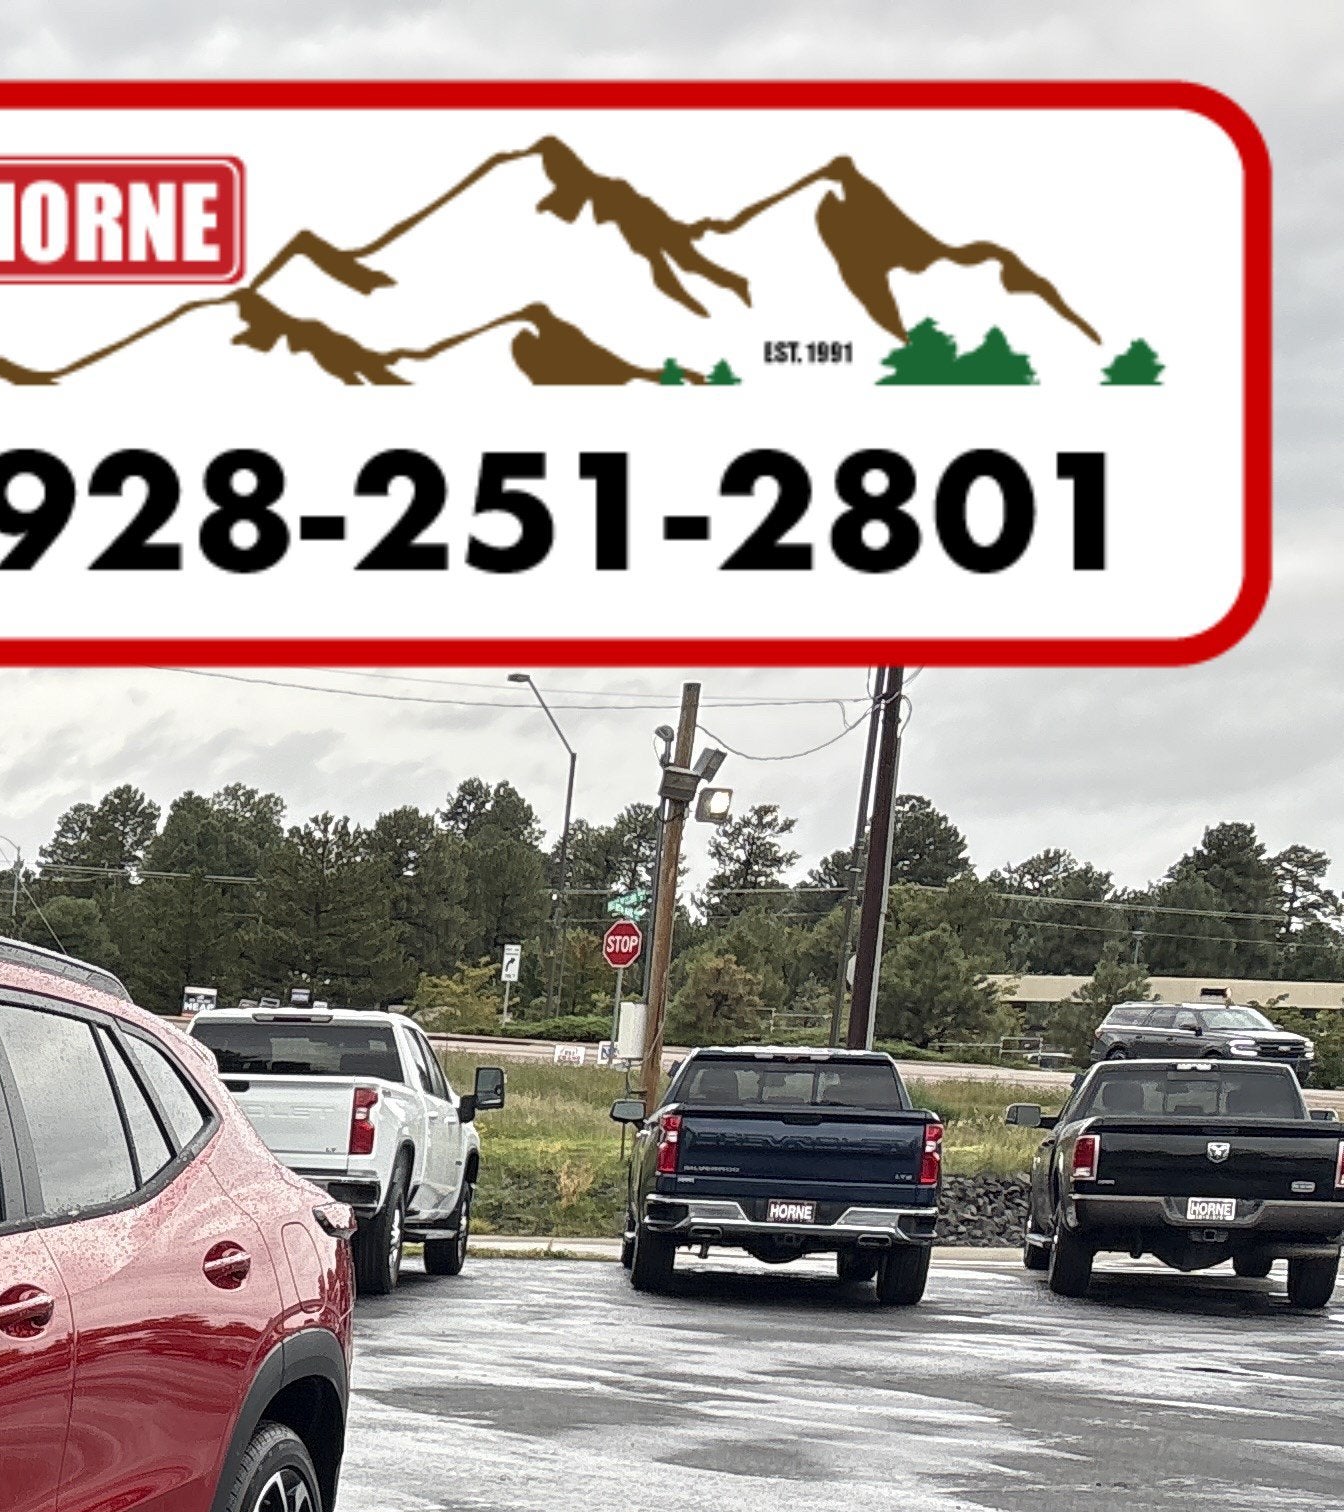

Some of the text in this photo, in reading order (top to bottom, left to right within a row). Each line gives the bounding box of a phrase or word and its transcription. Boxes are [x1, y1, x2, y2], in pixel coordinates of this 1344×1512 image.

[606, 935, 639, 953] STOP
[769, 1203, 813, 1220] HORNE
[1190, 1201, 1232, 1216] HORNE
